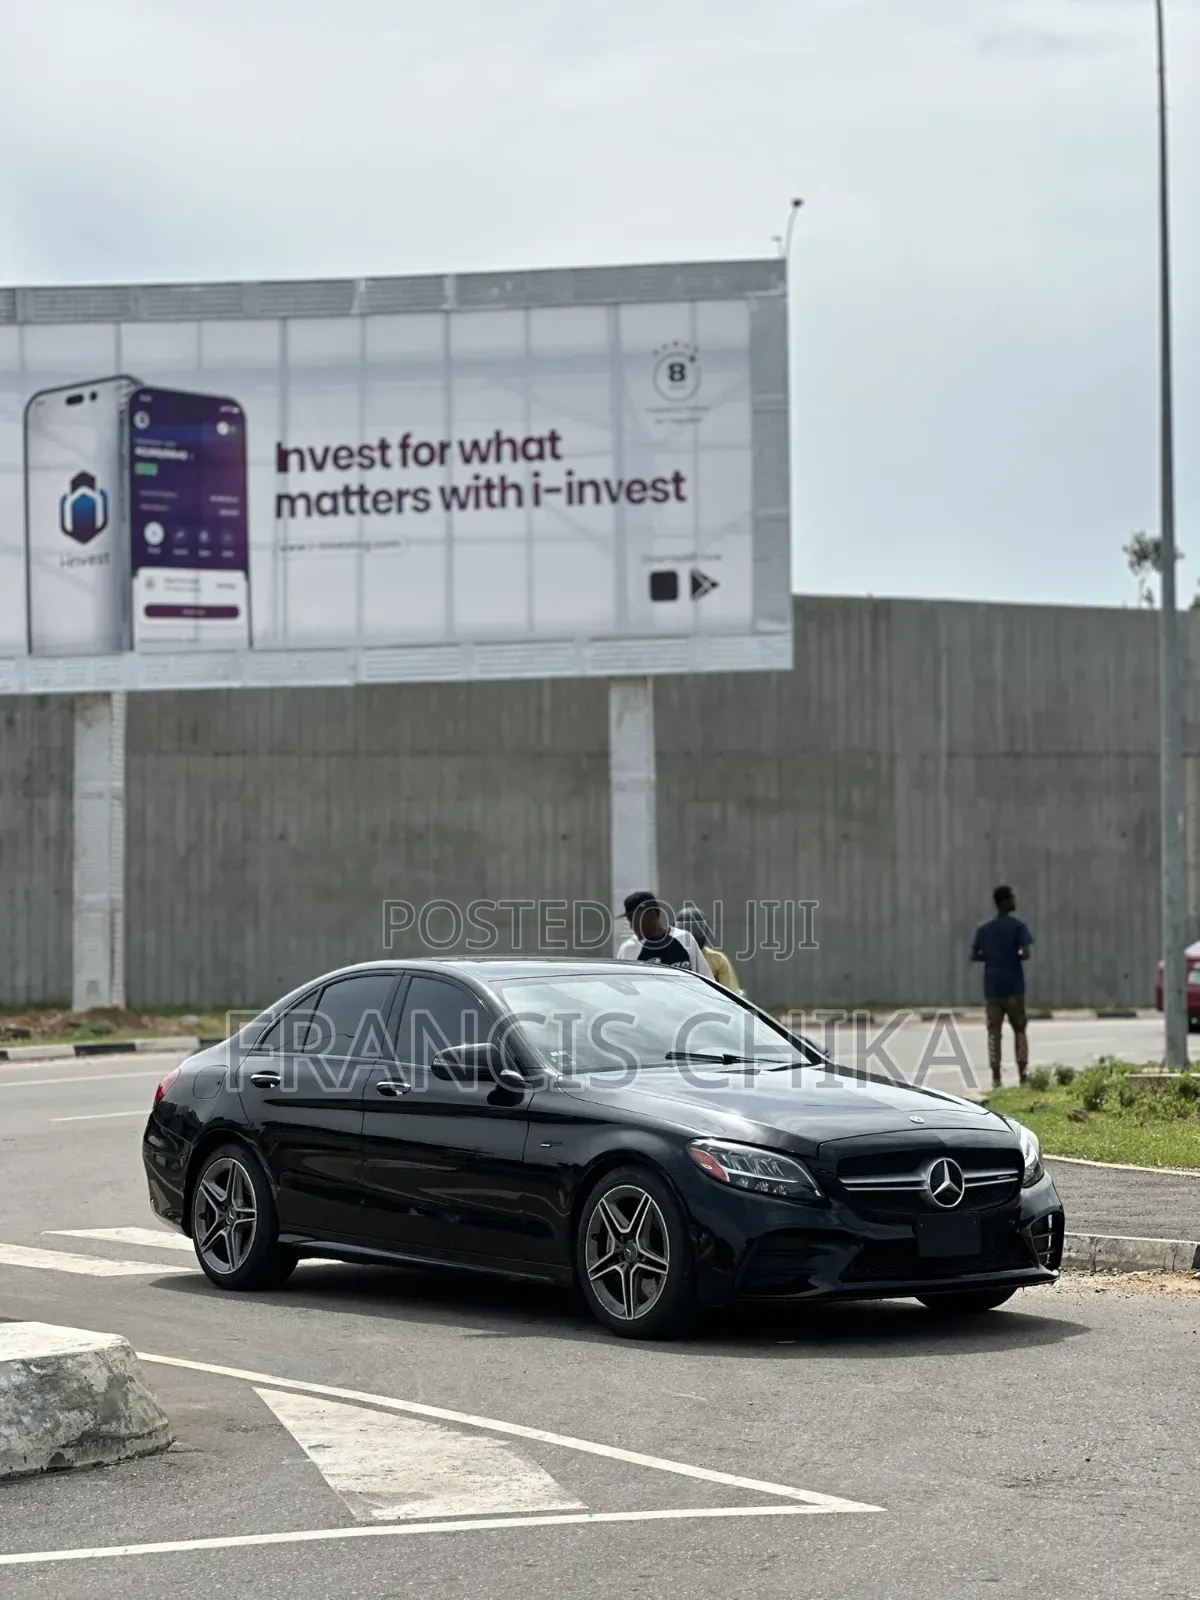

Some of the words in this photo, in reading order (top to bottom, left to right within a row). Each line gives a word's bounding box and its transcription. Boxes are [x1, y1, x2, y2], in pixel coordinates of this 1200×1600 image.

[275, 438, 392, 474] Invest
[397, 430, 452, 469] for
[456, 427, 562, 466] what
[274, 482, 432, 520] matters
[437, 470, 525, 513] with
[531, 467, 688, 508] i-invest
